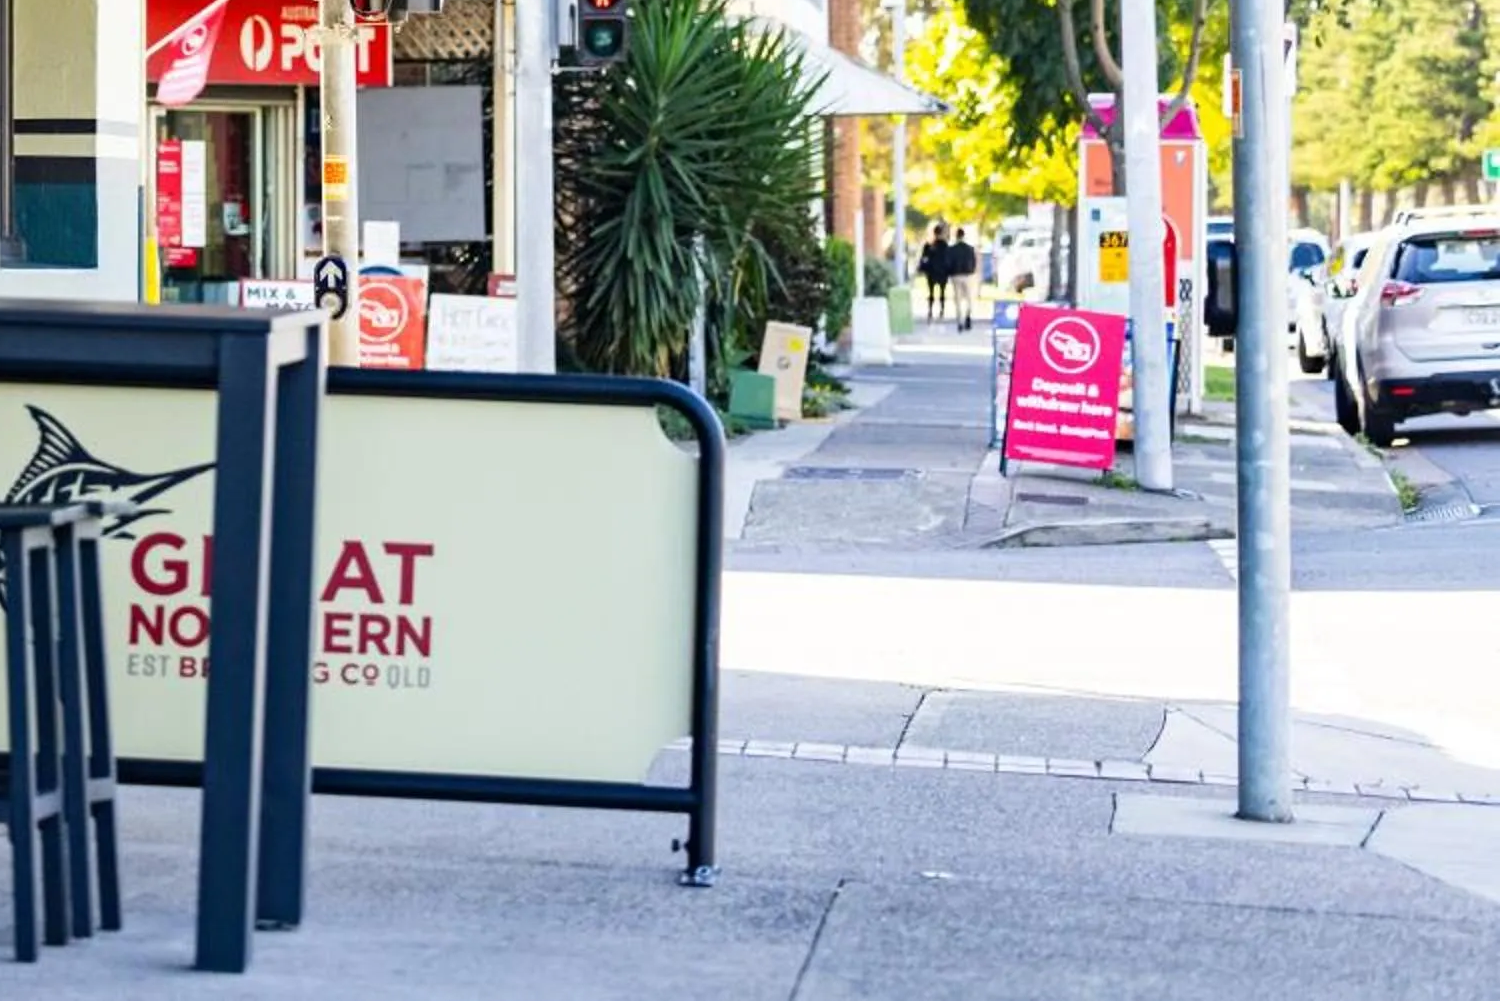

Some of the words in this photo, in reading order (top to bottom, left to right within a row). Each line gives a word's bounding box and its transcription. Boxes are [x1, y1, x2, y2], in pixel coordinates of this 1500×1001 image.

[281, 24, 376, 73] POT
[247, 286, 279, 300] MIX
[130, 532, 434, 605] GAT
[129, 603, 432, 657] NOERN
[126, 653, 171, 678] EST
[386, 664, 431, 689] QLD
